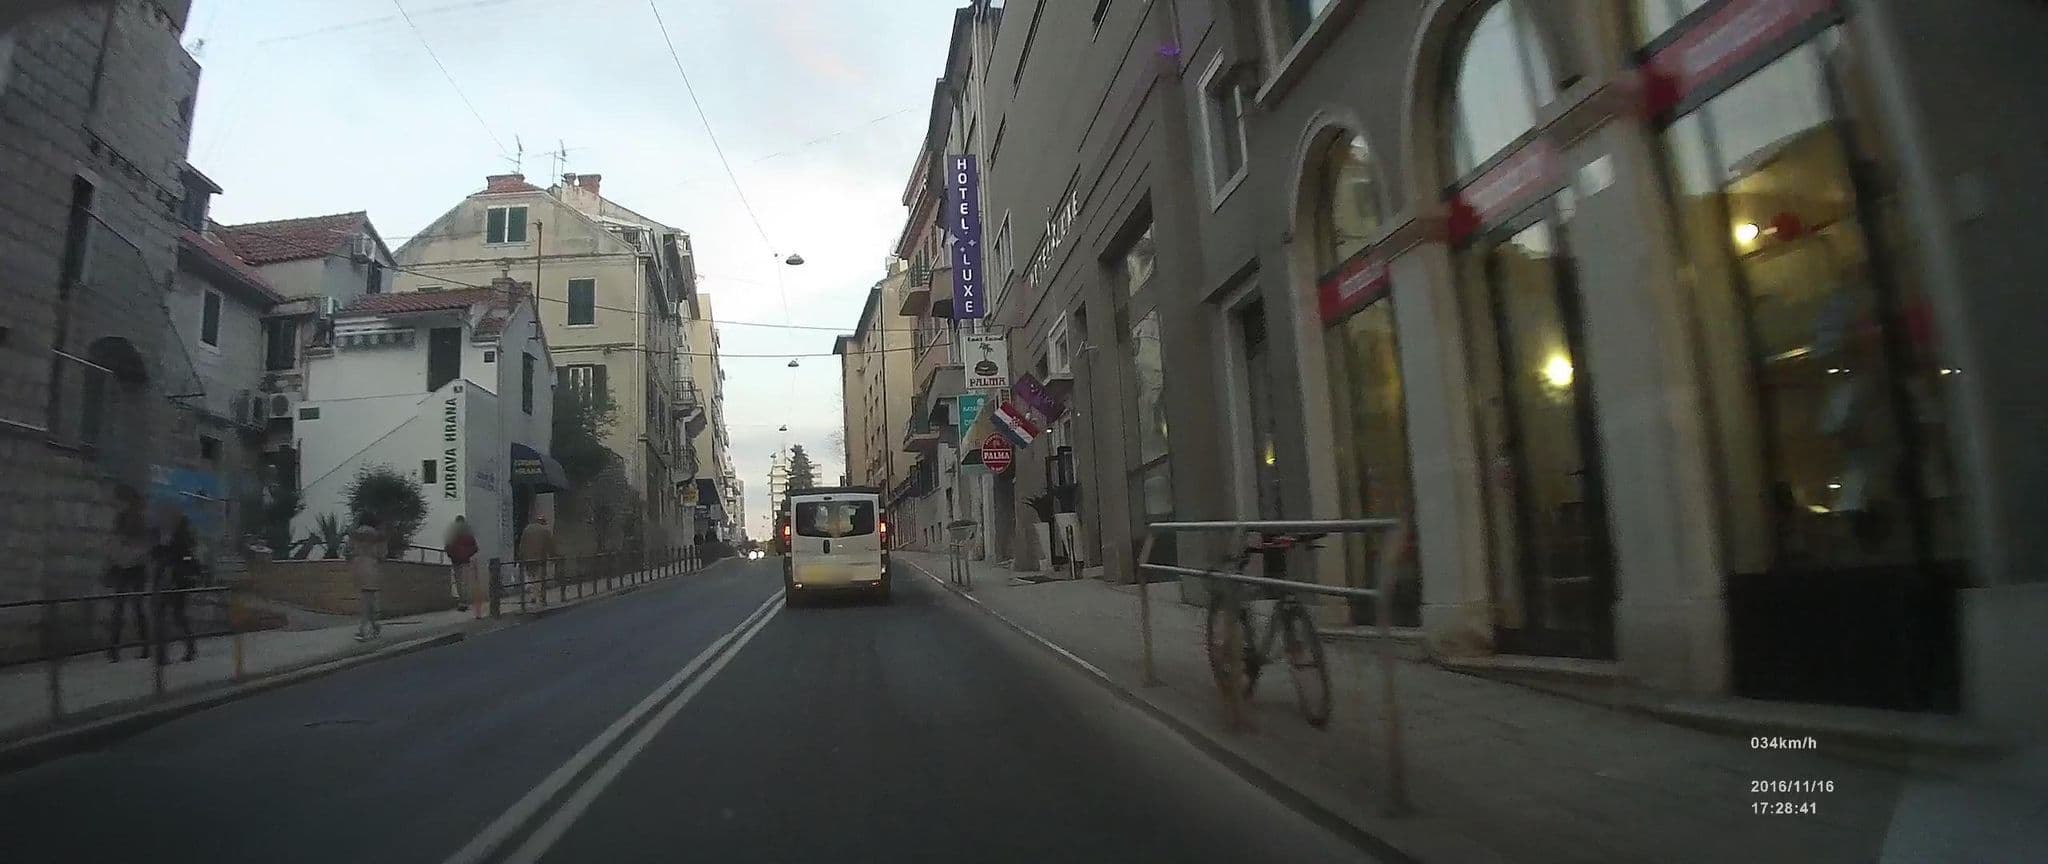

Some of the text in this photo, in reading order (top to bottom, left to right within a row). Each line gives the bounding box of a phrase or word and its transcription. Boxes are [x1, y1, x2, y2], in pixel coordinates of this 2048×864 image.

[957, 159, 974, 313] HOTEL LUXE
[970, 377, 1006, 387] PALMA
[445, 397, 457, 499] ZDRAVA HRANA
[983, 451, 1010, 460] PALMA
